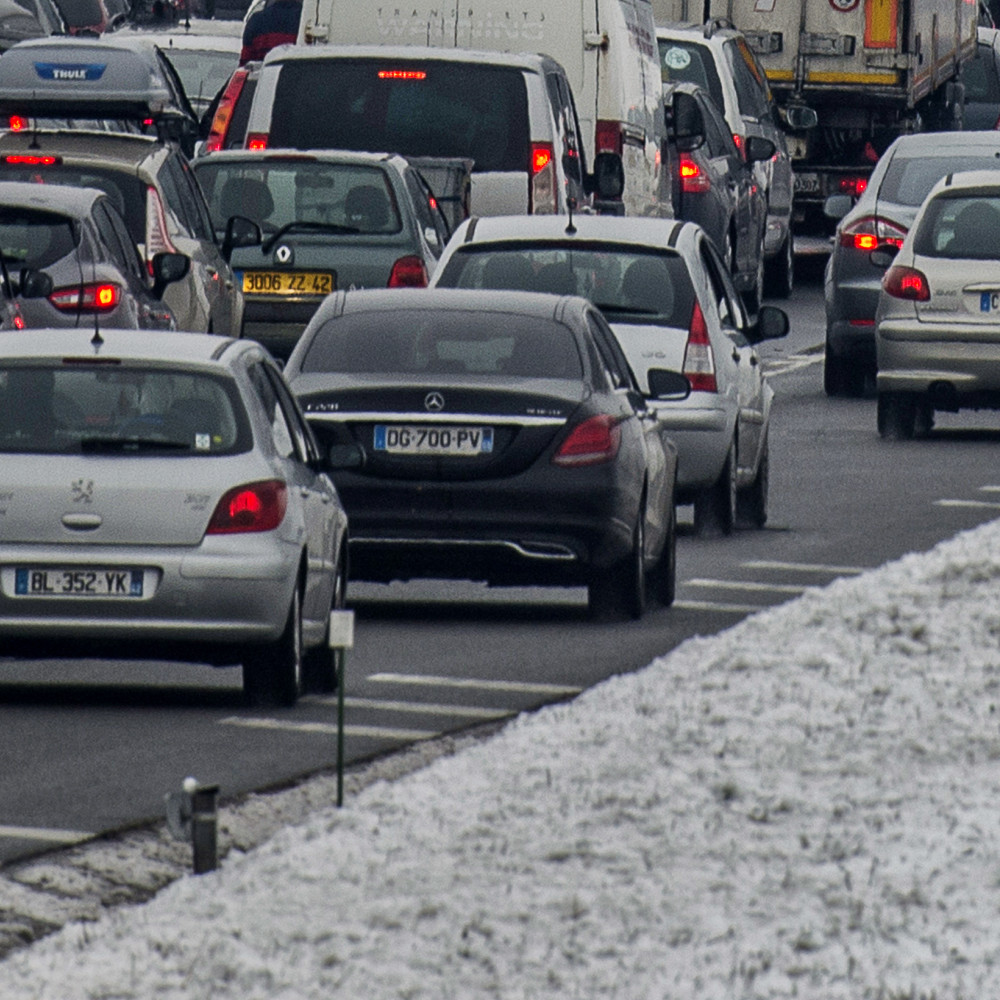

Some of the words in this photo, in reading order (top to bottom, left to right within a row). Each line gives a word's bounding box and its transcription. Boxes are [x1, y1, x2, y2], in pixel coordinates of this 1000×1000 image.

[52, 69, 88, 80] THULE
[246, 272, 282, 292] 3006
[288, 273, 307, 292] ZZ
[311, 275, 331, 293] 42
